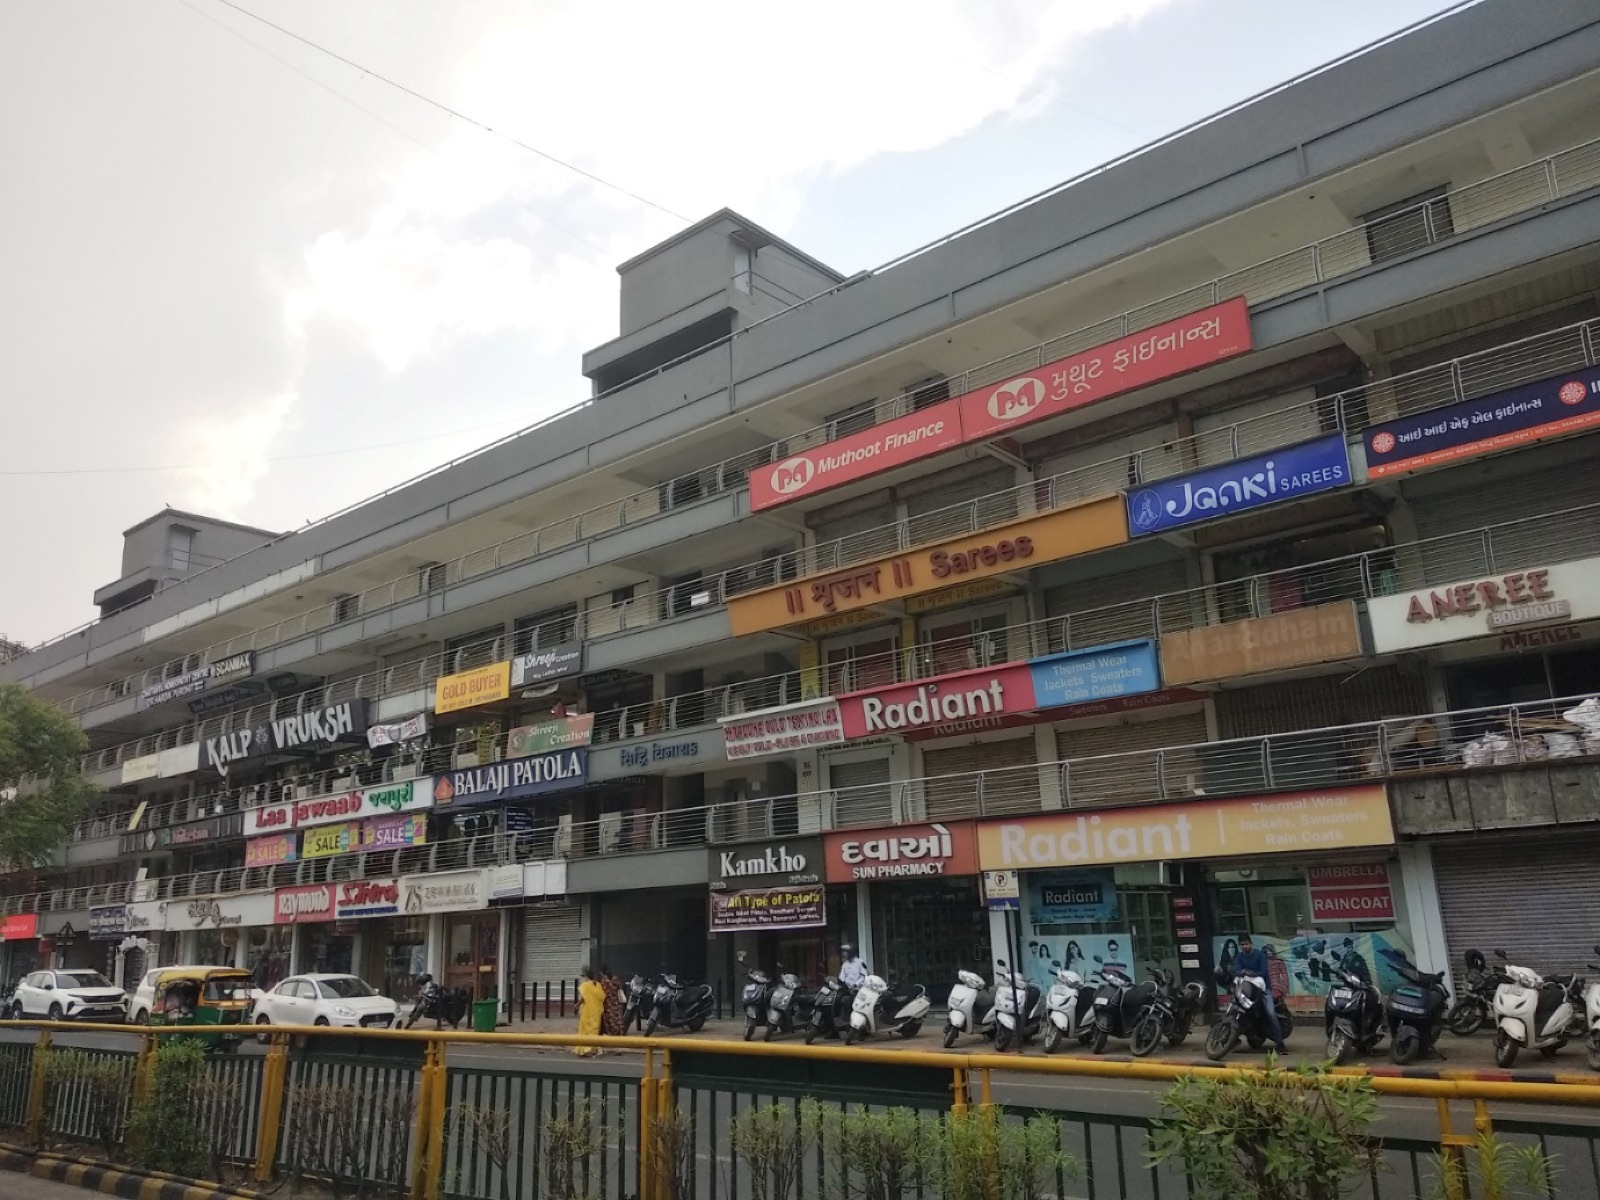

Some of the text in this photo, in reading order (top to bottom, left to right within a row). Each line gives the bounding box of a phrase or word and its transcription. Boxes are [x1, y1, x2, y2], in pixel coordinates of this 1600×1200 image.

[1050, 358, 1103, 401] મુથૂટ
[817, 441, 881, 474] Muthoot
[884, 420, 945, 451] Finance
[1166, 460, 1343, 518] Janki SAREES
[930, 536, 1034, 577] Sarees
[1406, 568, 1555, 624] ANEREE
[1493, 601, 1565, 625] BOUTIQUE
[1052, 655, 1128, 676] Thermal Wear
[443, 682, 467, 700] GOLD
[470, 674, 501, 693] BUYER
[1044, 666, 1143, 691] Jackets Sweaters
[1065, 682, 1125, 700] Rain Coats
[862, 680, 1004, 732] Radiant
[206, 702, 353, 776] KALP VRUKSH
[550, 730, 590, 746] Creation
[455, 751, 582, 796] BALAJI PATOLA
[256, 807, 286, 828] Laa
[291, 791, 364, 826] jawaab
[1251, 796, 1349, 815] Thermal Wear
[1239, 812, 1368, 830] Jackets, Sweaters
[315, 835, 341, 852] SALE
[376, 827, 405, 844] SALE
[1000, 815, 1192, 864] Radiant
[1266, 829, 1343, 845] Rain Coats
[256, 845, 280, 861] SALE
[720, 846, 807, 877] Kamkho
[853, 862, 944, 879] SUN PHARMACY
[1311, 866, 1384, 879] UMBRELLA
[744, 895, 769, 909] Type
[771, 894, 783, 905] of
[1046, 889, 1099, 904] Radiant
[1314, 896, 1390, 910] RAINCOAT
